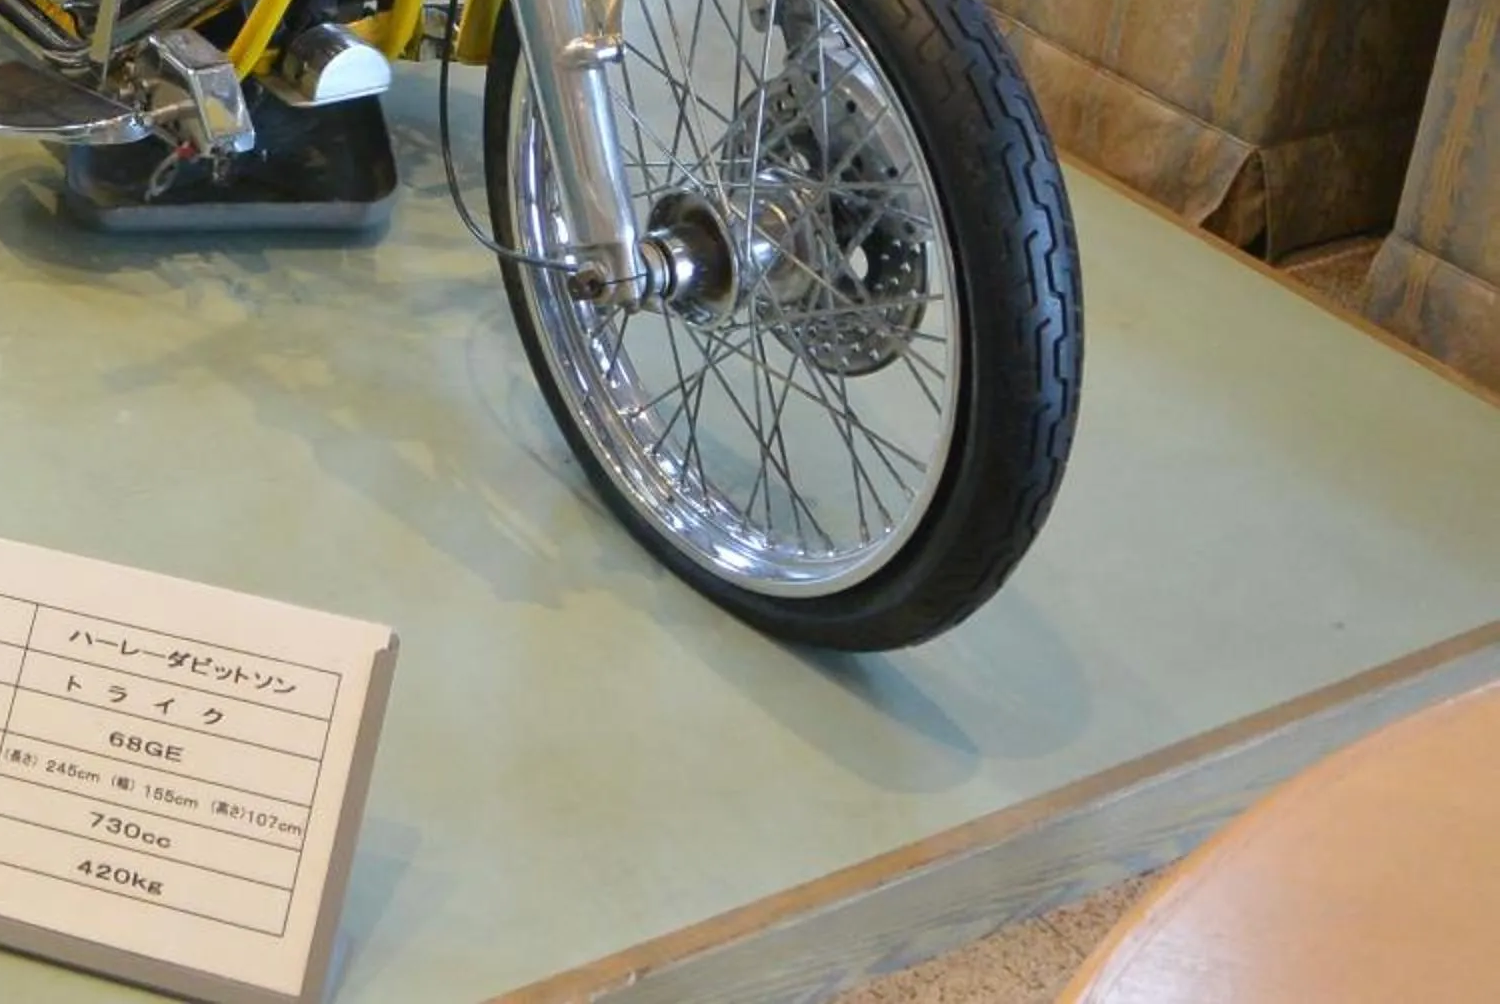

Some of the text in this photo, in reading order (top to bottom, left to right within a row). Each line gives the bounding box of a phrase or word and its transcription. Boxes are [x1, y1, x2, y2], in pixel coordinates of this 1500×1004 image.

[66, 675, 224, 725] トライク
[109, 731, 185, 762] 68GE
[89, 811, 171, 850] 730cc
[77, 861, 164, 896] 420kg
